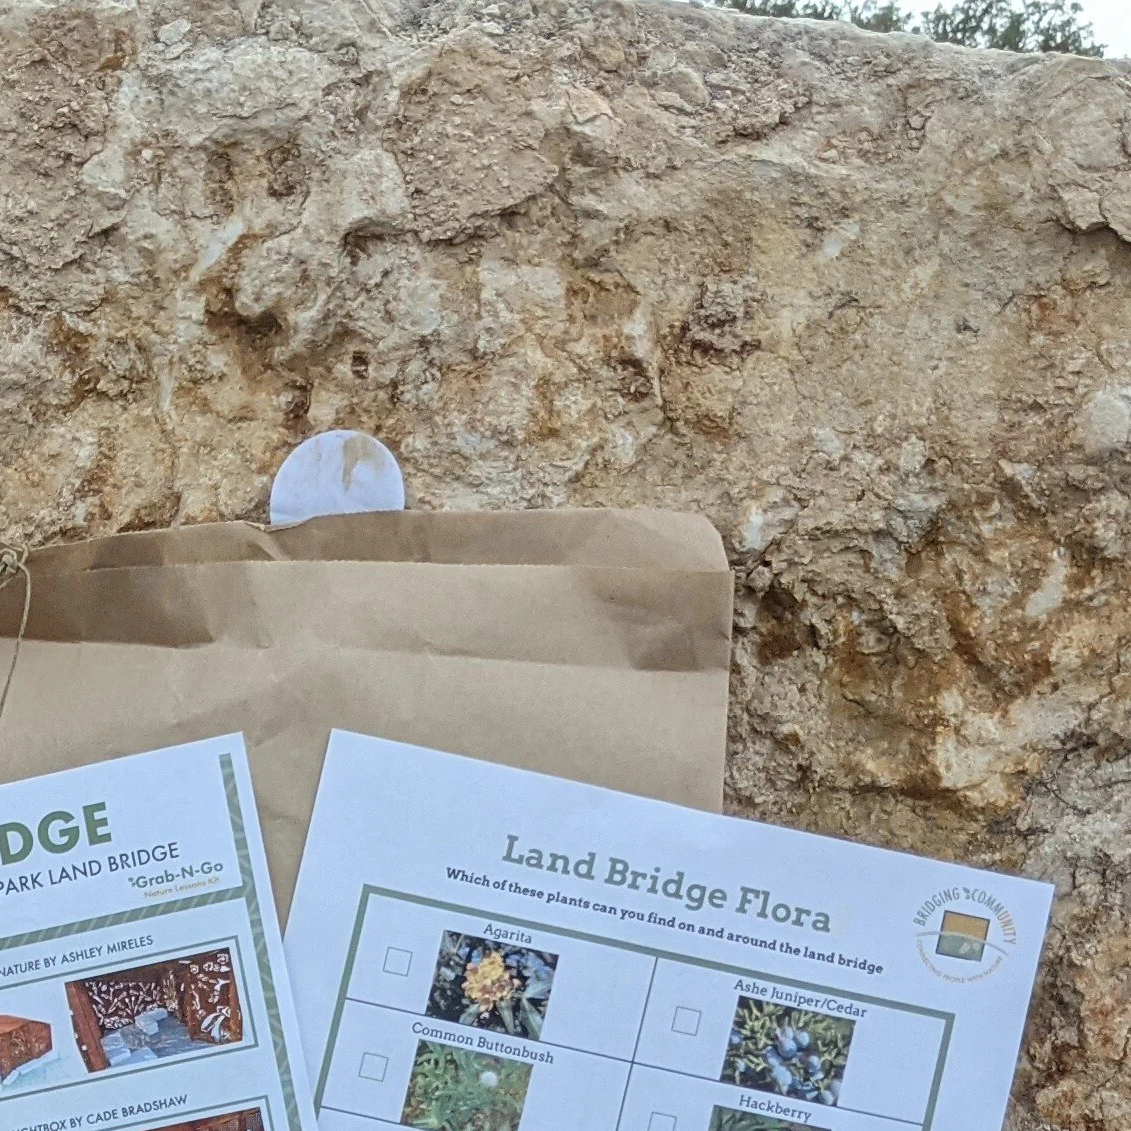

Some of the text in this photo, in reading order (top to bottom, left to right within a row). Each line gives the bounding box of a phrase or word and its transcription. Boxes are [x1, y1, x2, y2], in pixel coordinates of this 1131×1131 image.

[48, 859, 101, 885] LAND
[107, 841, 179, 872] BRIDGE
[135, 861, 223, 888] Grab-N-Go
[501, 834, 830, 933] Land Bridge Flora
[446, 867, 883, 974] Which of these plants can you find on and around the land bridge
[483, 923, 531, 944] Agarita
[913, 888, 1016, 944] BRIDGING COMMUNITY
[43, 956, 56, 968] BY
[60, 945, 102, 964] ASHLEY
[107, 934, 153, 954] MIRELES
[733, 979, 867, 1017] Ashe Juniper/Cedar
[411, 1021, 553, 1064] Common Buttonbush
[69, 1116, 82, 1128] BY
[86, 1108, 118, 1124] CADE
[121, 1094, 187, 1117] BRADSHAW
[739, 1094, 811, 1123] Hackberry
